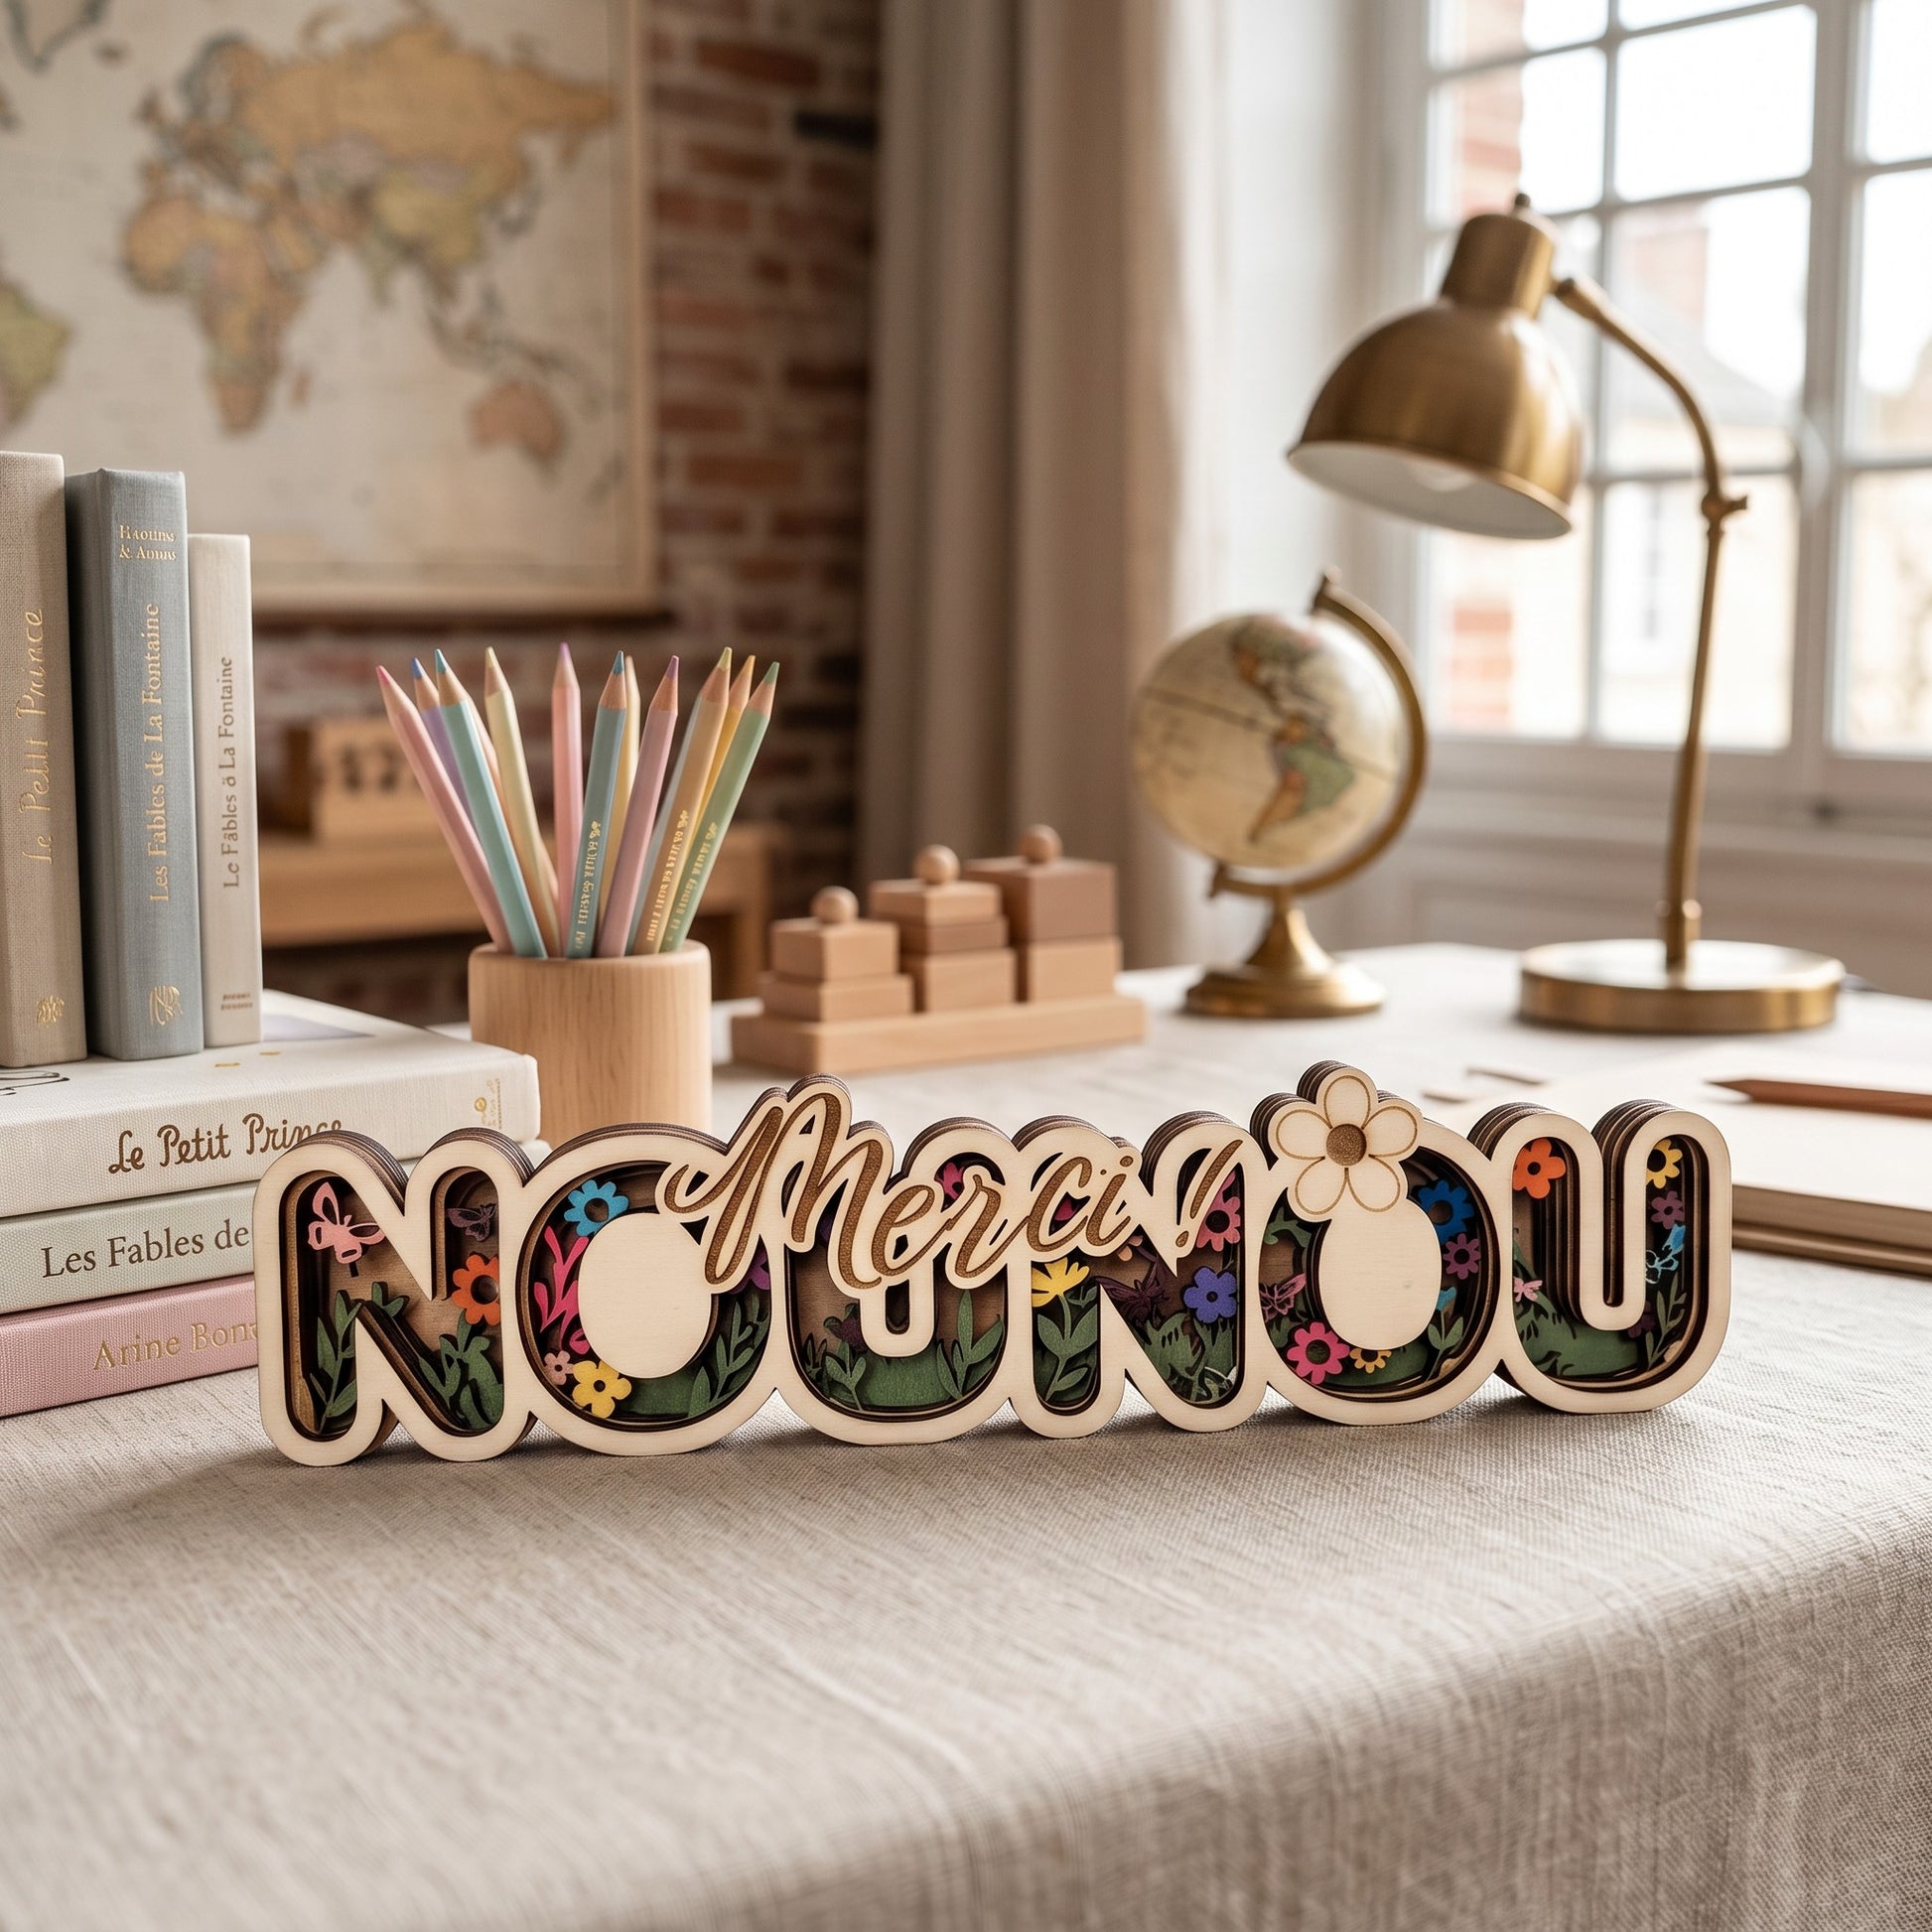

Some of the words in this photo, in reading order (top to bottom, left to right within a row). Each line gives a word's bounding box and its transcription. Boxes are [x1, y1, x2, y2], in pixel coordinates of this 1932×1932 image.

[15, 608, 47, 719] Prince
[140, 603, 162, 705] Fontaine
[215, 656, 235, 739] Fontaine
[143, 714, 163, 743] La
[144, 750, 164, 777] de
[217, 747, 236, 769] La
[145, 783, 167, 857] Fables
[149, 865, 170, 902] Les
[107, 1130, 145, 1174] Le
[156, 1123, 231, 1168] Petit
[40, 1245, 96, 1279] Les
[106, 1226, 205, 1268] Fables
[213, 1218, 250, 1251] de
[254, 1098, 1733, 1468] NOUNOU
[92, 1333, 182, 1371] Arine
